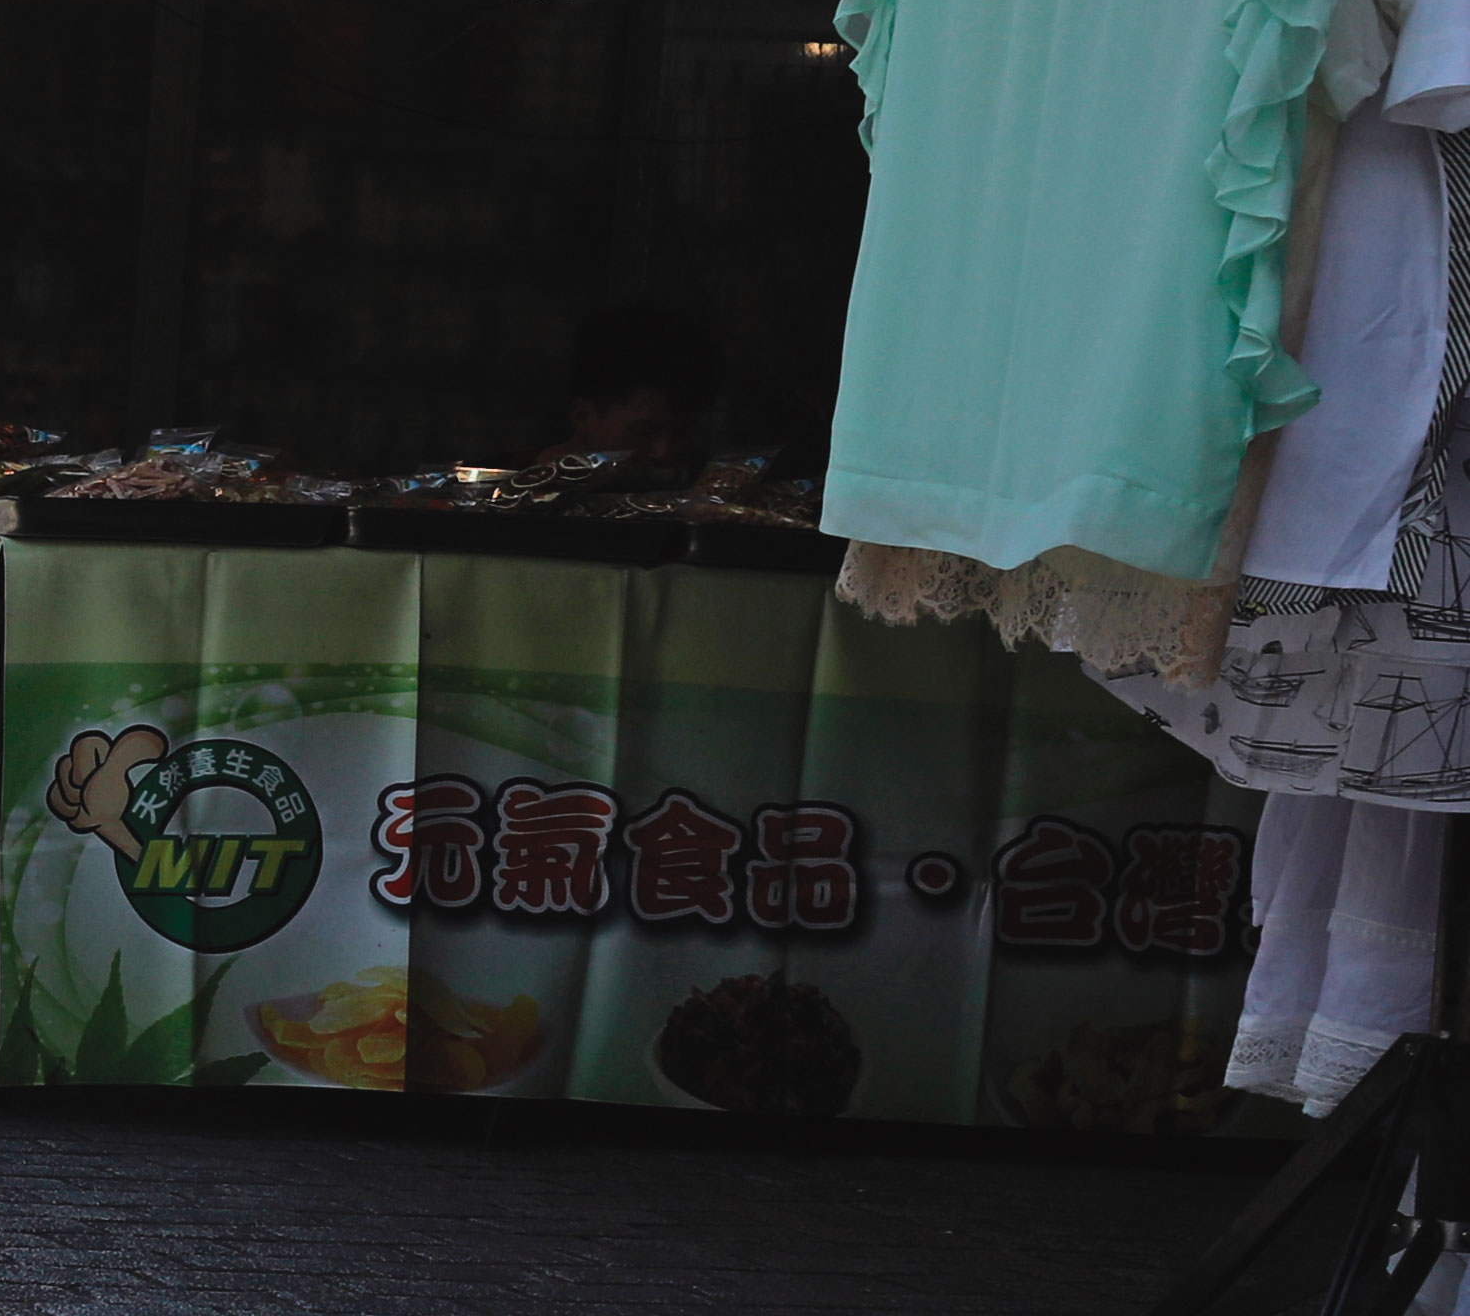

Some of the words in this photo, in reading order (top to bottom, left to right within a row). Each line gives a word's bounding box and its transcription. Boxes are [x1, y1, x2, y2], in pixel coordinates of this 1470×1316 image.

[130, 747, 307, 826] 天然養生食品
[132, 838, 307, 889] MIT
